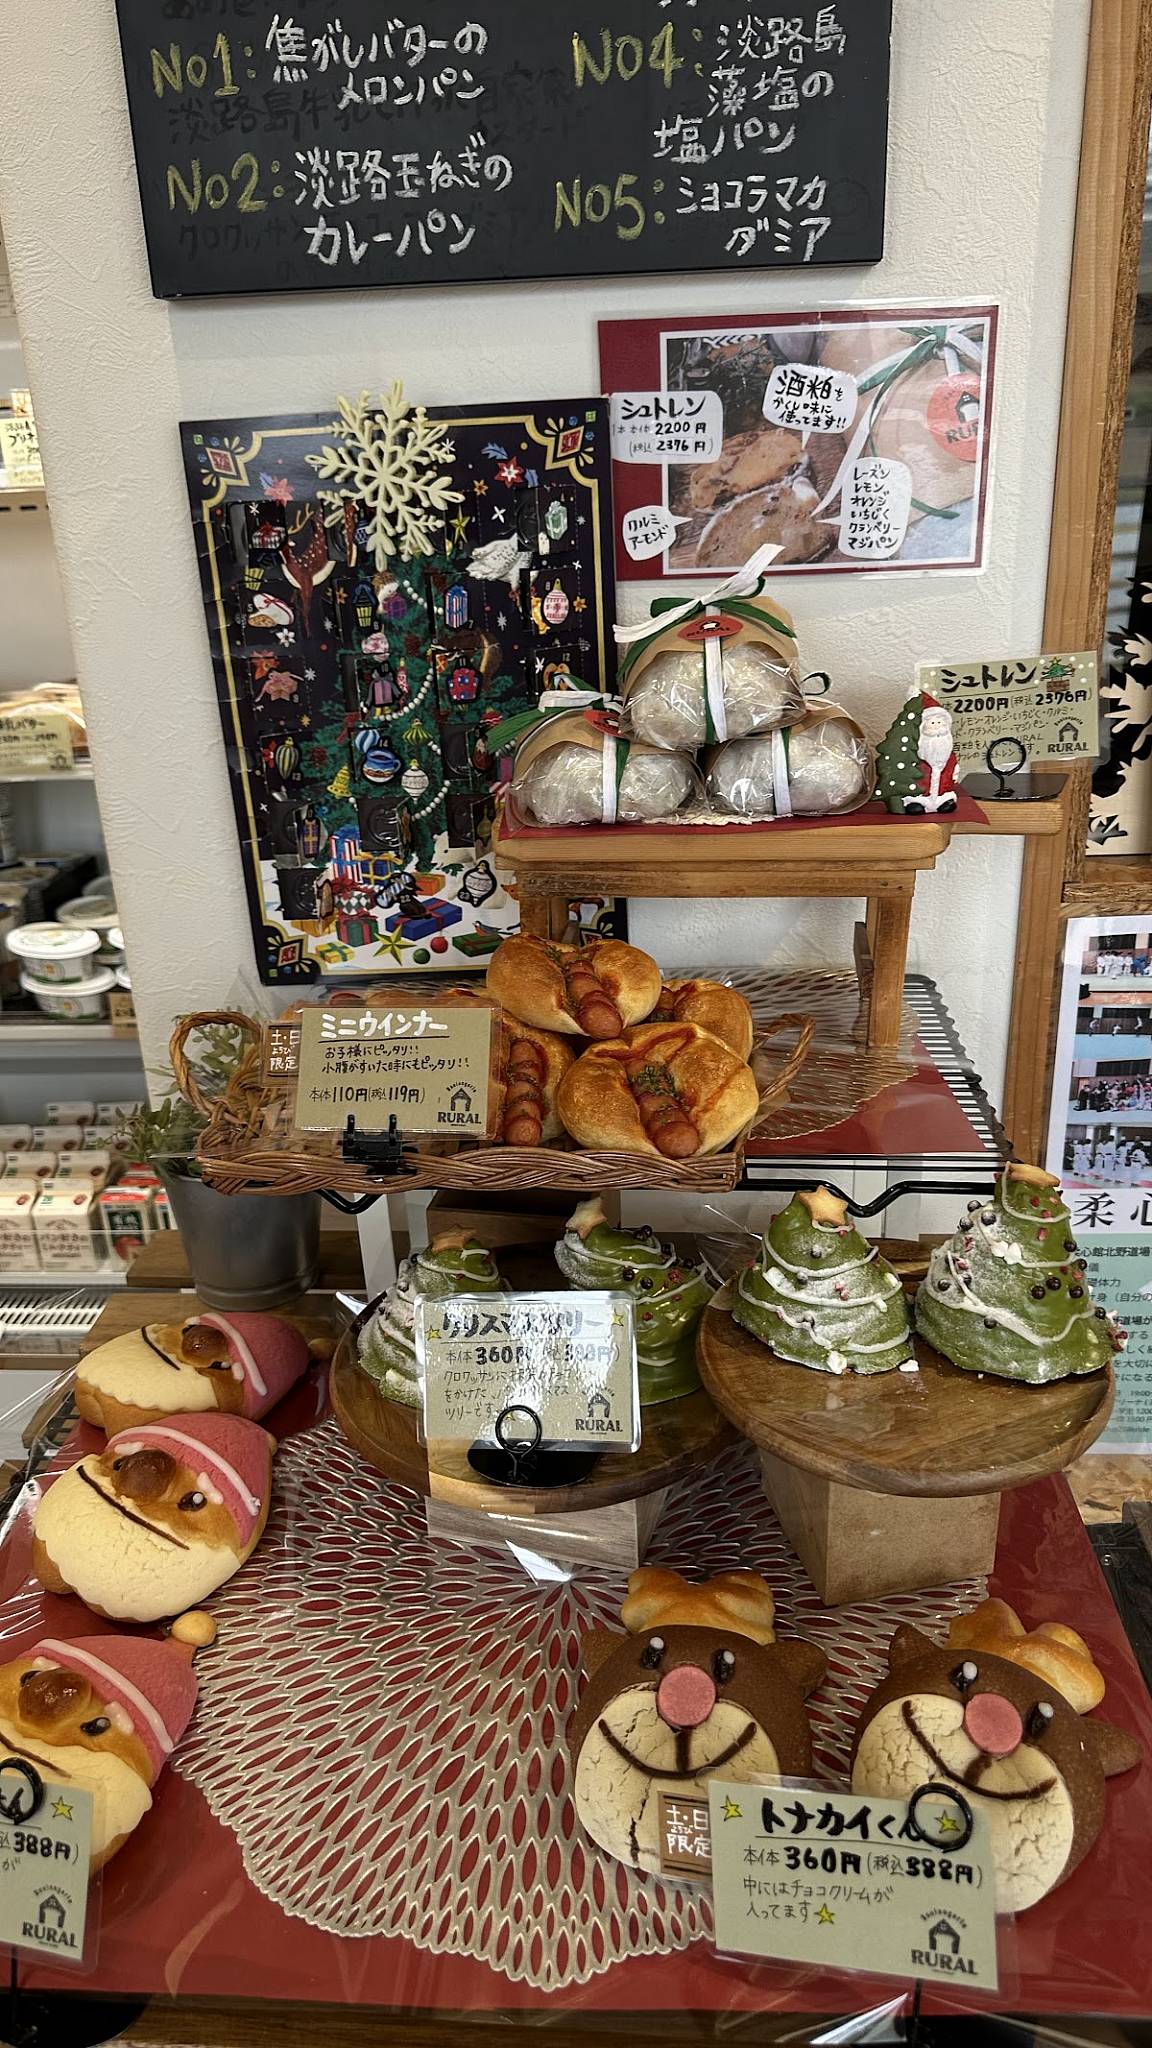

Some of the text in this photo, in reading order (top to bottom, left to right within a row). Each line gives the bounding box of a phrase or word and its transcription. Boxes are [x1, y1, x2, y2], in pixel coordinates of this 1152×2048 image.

[716, 4, 846, 63] 淡路島
[265, 14, 488, 83] 焦がしバターの
[337, 66, 485, 110] メロンパン
[706, 64, 835, 117] 藻塩の
[653, 114, 797, 163] 塩パン
[294, 131, 514, 210] 淡路玉ねぎの
[676, 174, 829, 213] ショコラマカ
[304, 208, 477, 265] カレーパン
[724, 216, 832, 262] ダミア
[775, 369, 844, 402] 酒粕を
[620, 395, 707, 420] シュトレン
[853, 463, 891, 481] レーズン
[850, 490, 890, 507] オレンジ
[855, 482, 885, 493] レモン
[627, 513, 661, 532] クルミ
[850, 508, 890, 520] いちじく
[628, 524, 669, 551] アーモンド
[848, 521, 901, 535] クランベリー
[847, 536, 899, 550] マジパン
[940, 662, 1038, 693] シュトレン
[1047, 741, 1090, 754] RURAL
[320, 1010, 449, 1038] ミニウインナー
[270, 1055, 299, 1071] 限定
[437, 1111, 482, 1124] RURAL
[575, 1418, 624, 1433] RURAL
[666, 1804, 709, 1831] 土・日
[761, 1796, 925, 1842] トナカイくん
[666, 1833, 712, 1858] 限定
[743, 1874, 895, 1905] 中にはチョコクリームが
[746, 1900, 811, 1924] 入ってます
[22, 1921, 79, 1949] RURAL
[910, 1948, 978, 1976] RURAL
